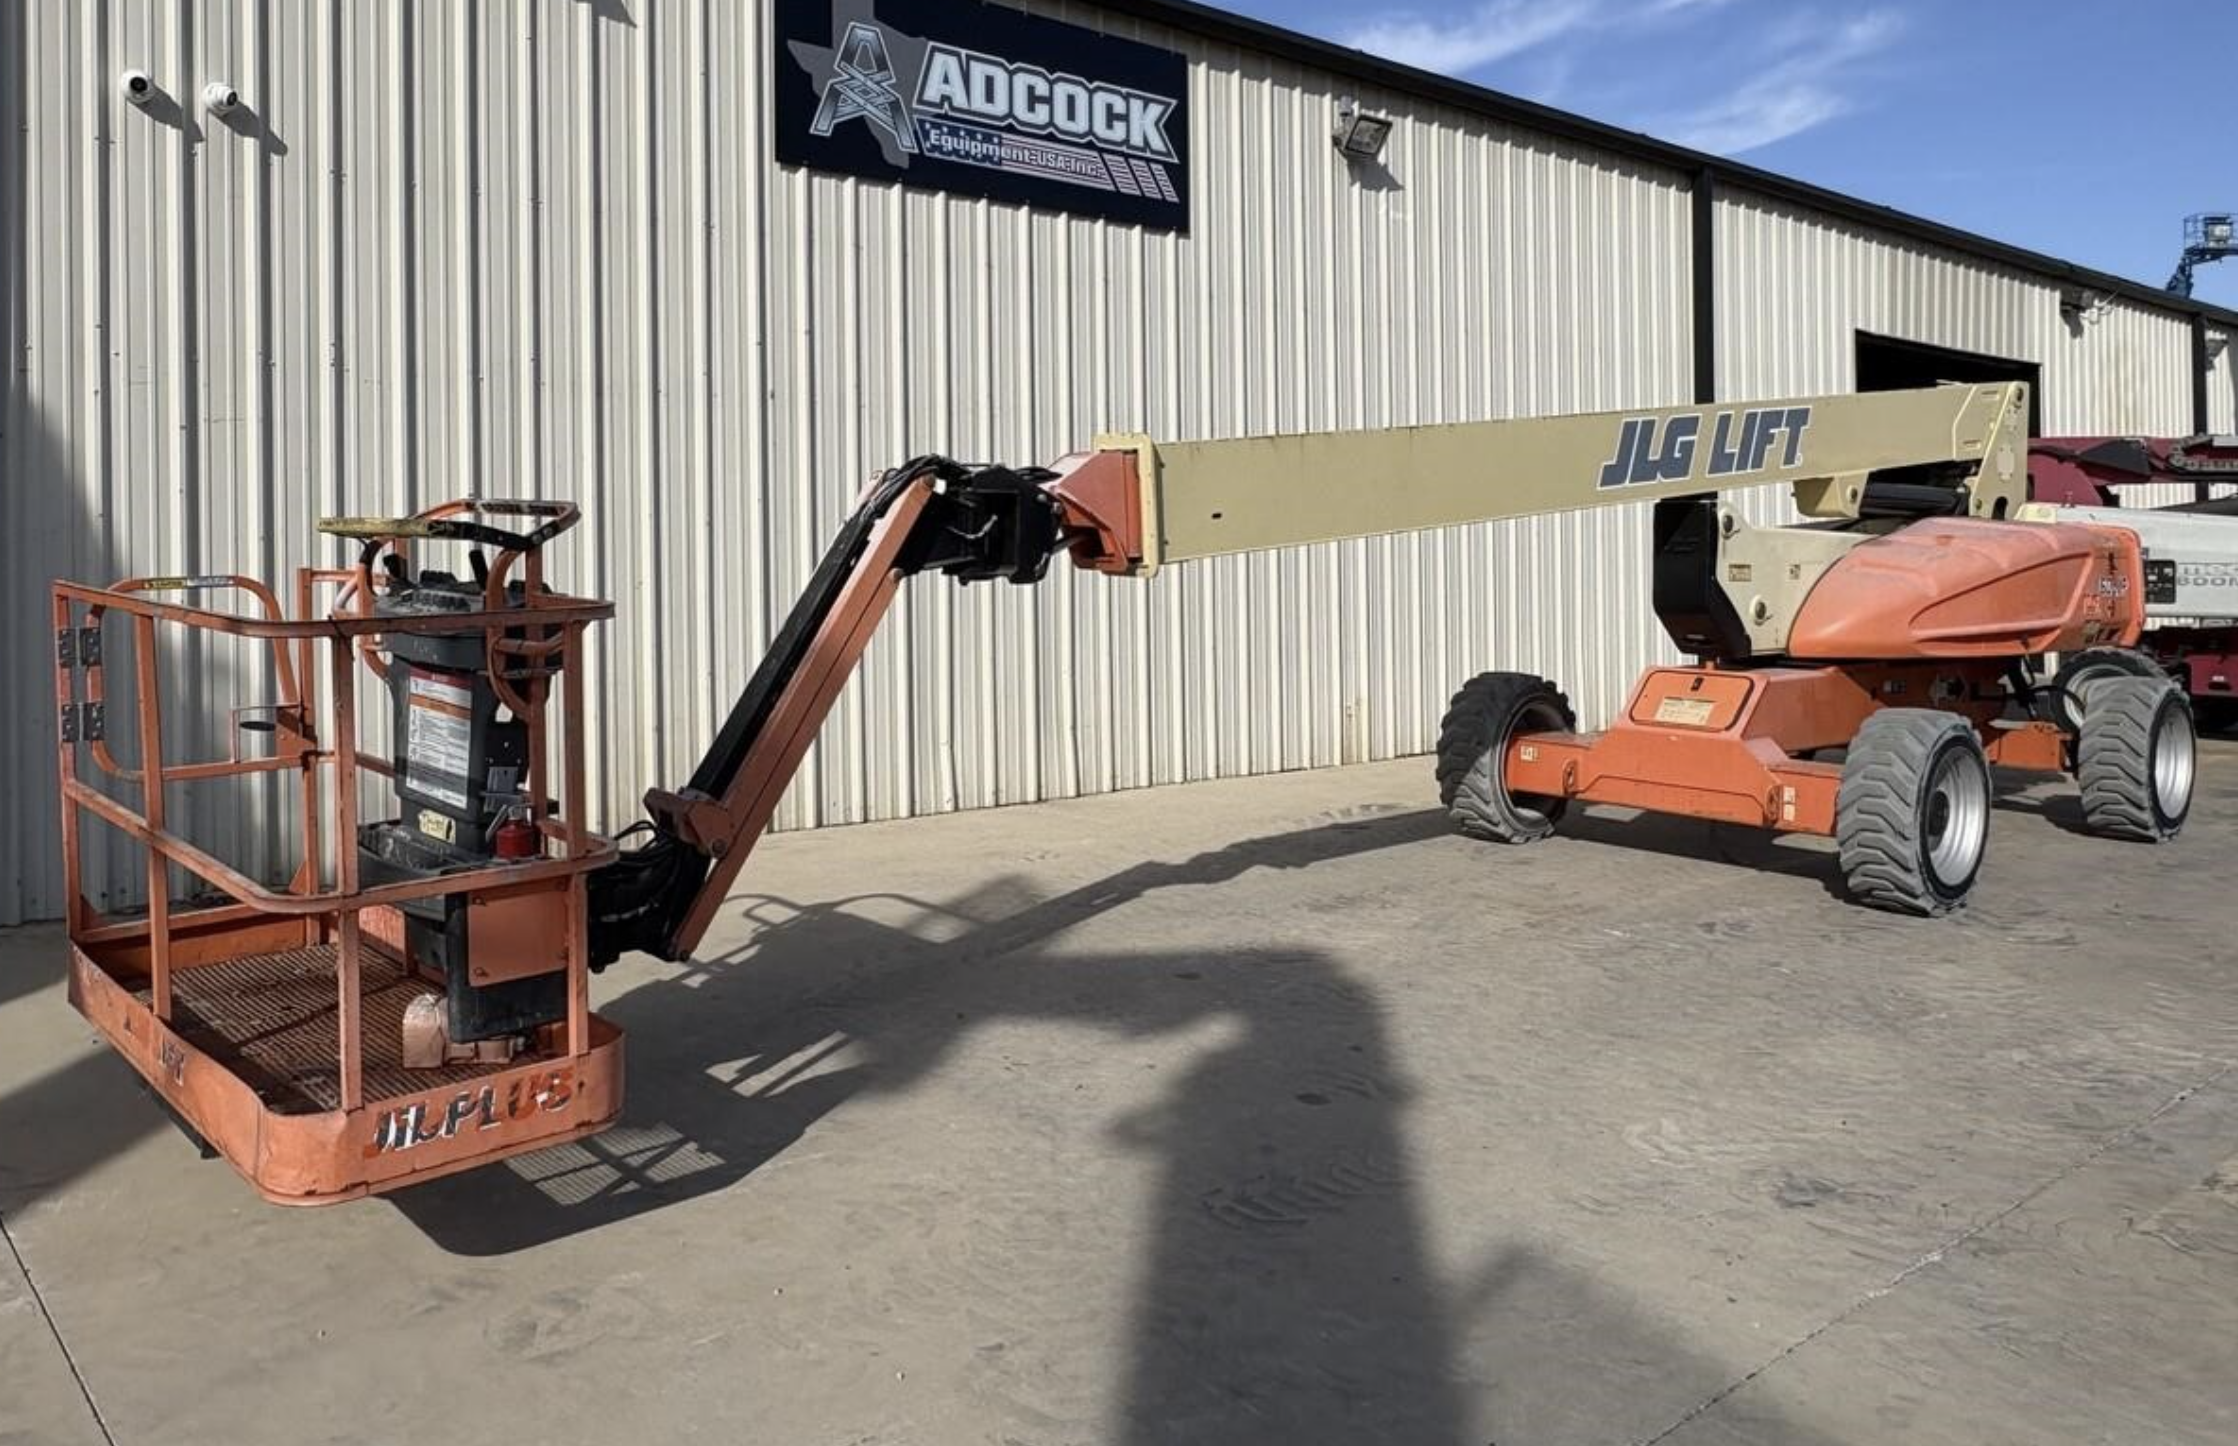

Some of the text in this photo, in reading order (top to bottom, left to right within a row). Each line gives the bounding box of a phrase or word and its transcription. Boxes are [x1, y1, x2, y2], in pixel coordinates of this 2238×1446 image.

[922, 51, 1168, 153] ADCOCK
[928, 128, 1031, 165] Equipment
[1037, 150, 1067, 169] USA
[1597, 406, 1812, 490] JLG LIFT
